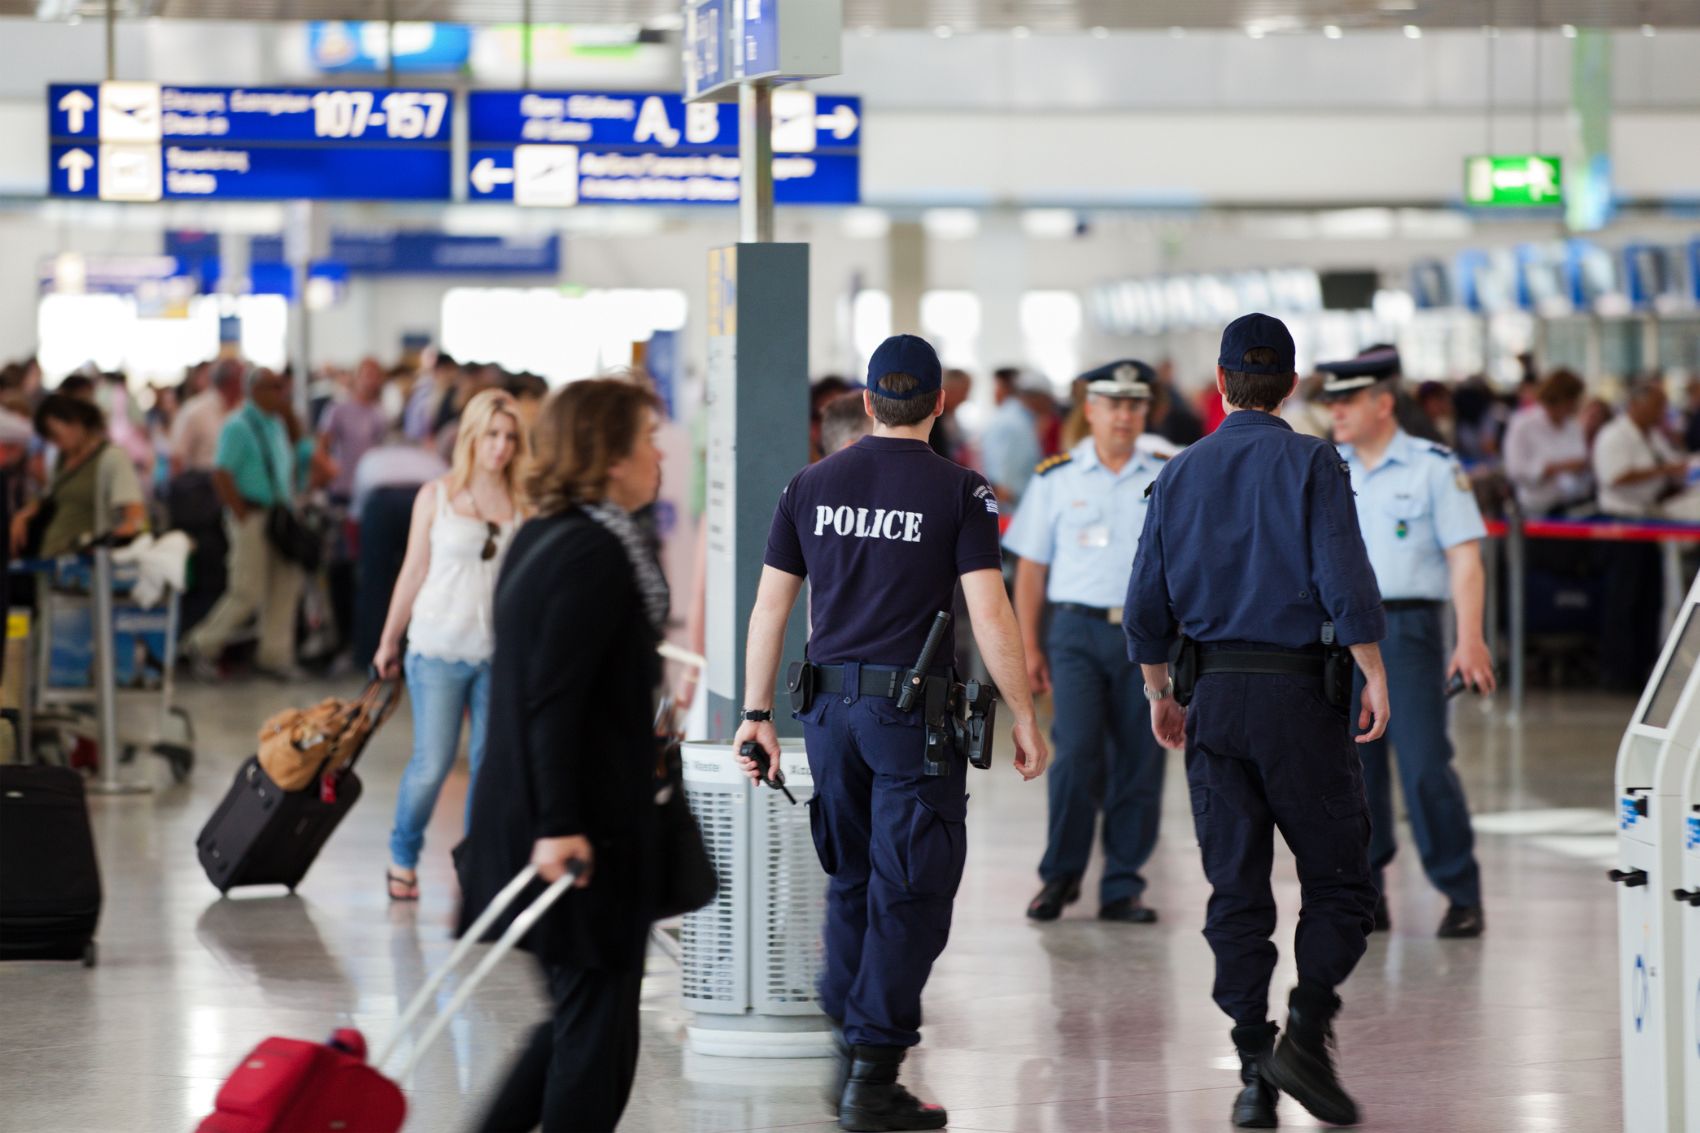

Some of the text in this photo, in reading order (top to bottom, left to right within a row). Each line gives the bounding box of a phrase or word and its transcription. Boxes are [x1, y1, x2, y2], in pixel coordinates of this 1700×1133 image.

[312, 91, 448, 138] 107-157
[686, 102, 720, 143] B
[814, 505, 923, 542] POLICE
